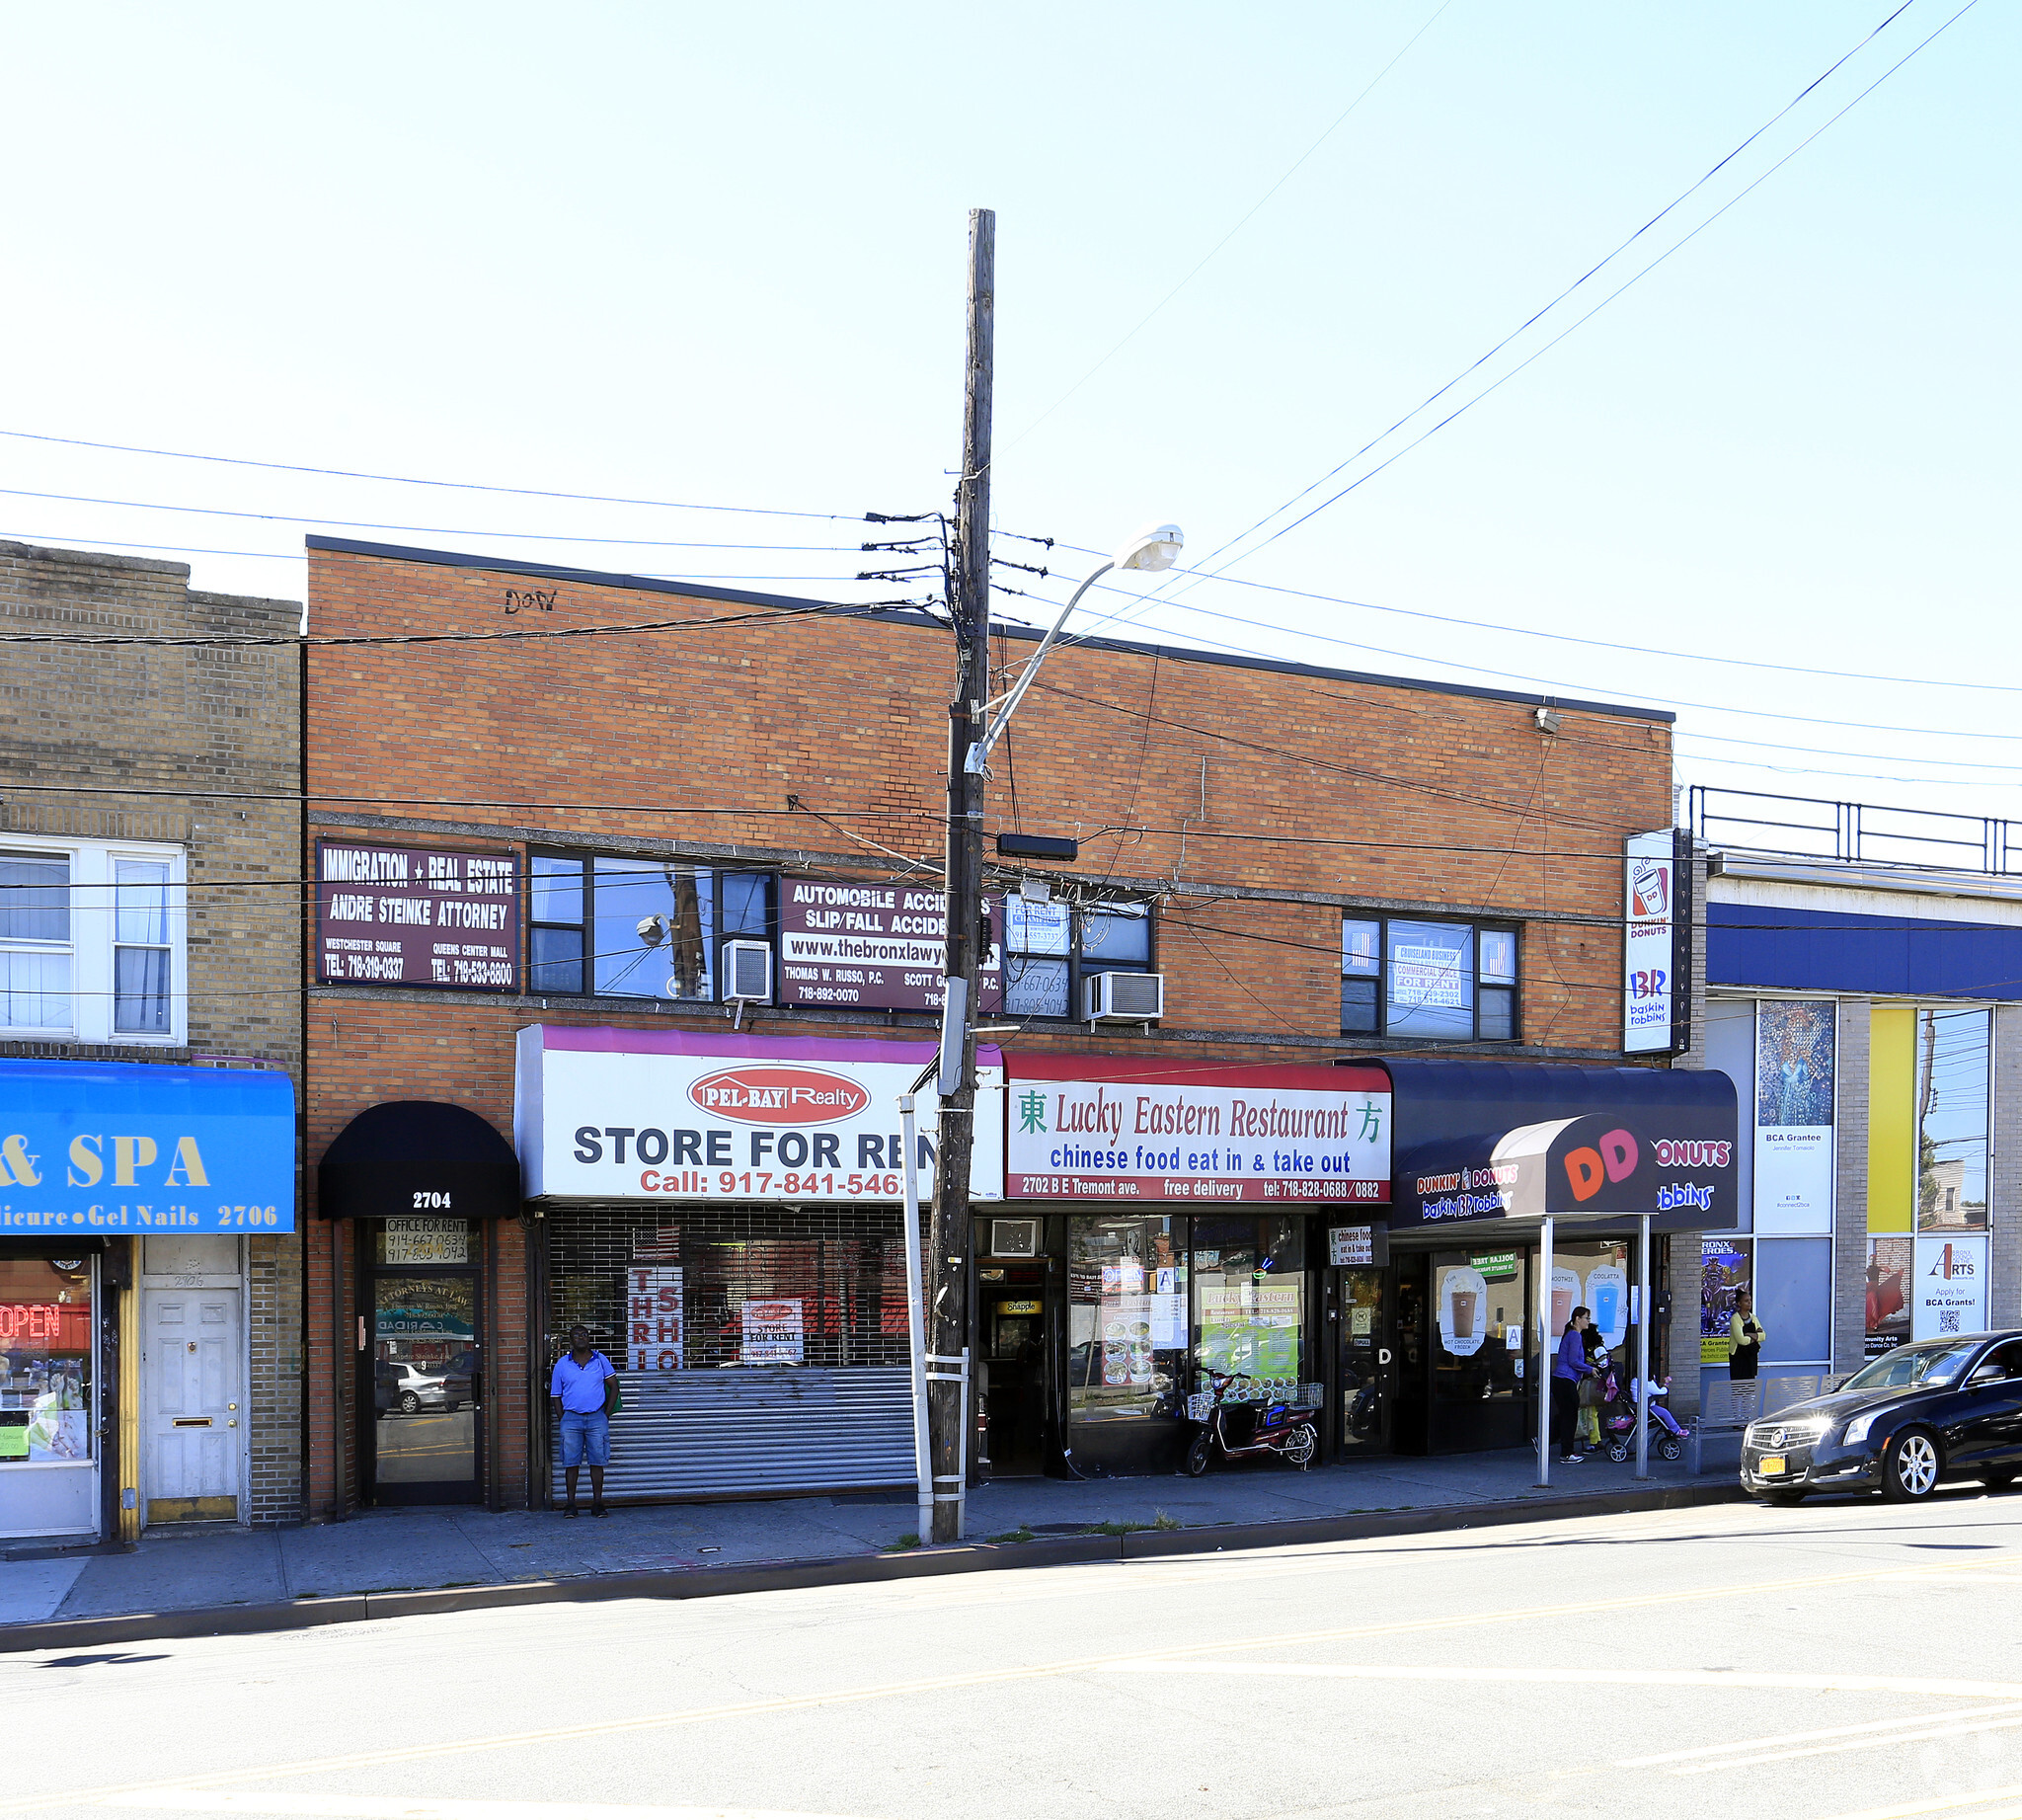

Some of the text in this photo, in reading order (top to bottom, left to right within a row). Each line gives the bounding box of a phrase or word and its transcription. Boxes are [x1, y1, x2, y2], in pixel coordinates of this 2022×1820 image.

[323, 848, 513, 895] IMMIGRATION REAL ESTATE
[793, 885, 991, 915] AUTOMOBILE ACCIS
[330, 893, 507, 930] ANDRE STEINKE ATTORNEY
[805, 910, 884, 933] SLIP/FALL
[1015, 931, 1058, 941] 91-557-3737
[1631, 926, 1667, 938] DONUTS
[325, 938, 402, 953] WESTCHESTER SQUARE
[432, 943, 508, 958] QUEENS CENTER MALL
[325, 954, 404, 980] TEL: 718-319-0337
[431, 959, 512, 985] TEL: 718-533-8800
[785, 967, 884, 986] THOMAS W. RUSSO, P.C.
[904, 973, 933, 987] SCOTT
[982, 978, 999, 990] P.C.
[1397, 978, 1458, 989] FOR RENT
[799, 987, 859, 1002] 718-892-0070
[706, 1086, 860, 1110] PEL-BAY Realty
[1018, 1089, 1048, 1135] 東
[1055, 1086, 1349, 1147] Lucky Eastern Restaurant
[1356, 1101, 1383, 1144] 方
[574, 1126, 974, 1169] STORE FOR REN
[1657, 1141, 1730, 1166] ONUTS
[0, 1134, 210, 1187] & SPA
[1050, 1144, 1351, 1173] chinese food eat in & take out
[1564, 1129, 1638, 1202] DD
[640, 1169, 903, 1195] Call: 917-841-546
[1022, 1176, 1140, 1195] 2702 B E Tremont ave.
[1164, 1178, 1243, 1200] free delivery
[1264, 1180, 1379, 1198] tel: 718-828-0688/0882
[1417, 1164, 1518, 1195] DUNKIN' DONUTS
[413, 1192, 451, 1208] 2704
[0, 1205, 277, 1226] icure Gel Nails 2706
[387, 1219, 466, 1232] OFFICE FOR RENT
[1338, 1229, 1360, 1242] chinese
[1103, 1267, 1143, 1283] OPEN
[1159, 1270, 1172, 1286] A
[1205, 1290, 1242, 1308] Lucky
[1935, 1288, 1954, 1297] Apply
[1007, 1301, 1036, 1311] Snapple
[0, 1305, 59, 1337] OPEN
[757, 1323, 788, 1333] STORE
[750, 1332, 796, 1342] FOR RENT
[1509, 1328, 1518, 1343] A
